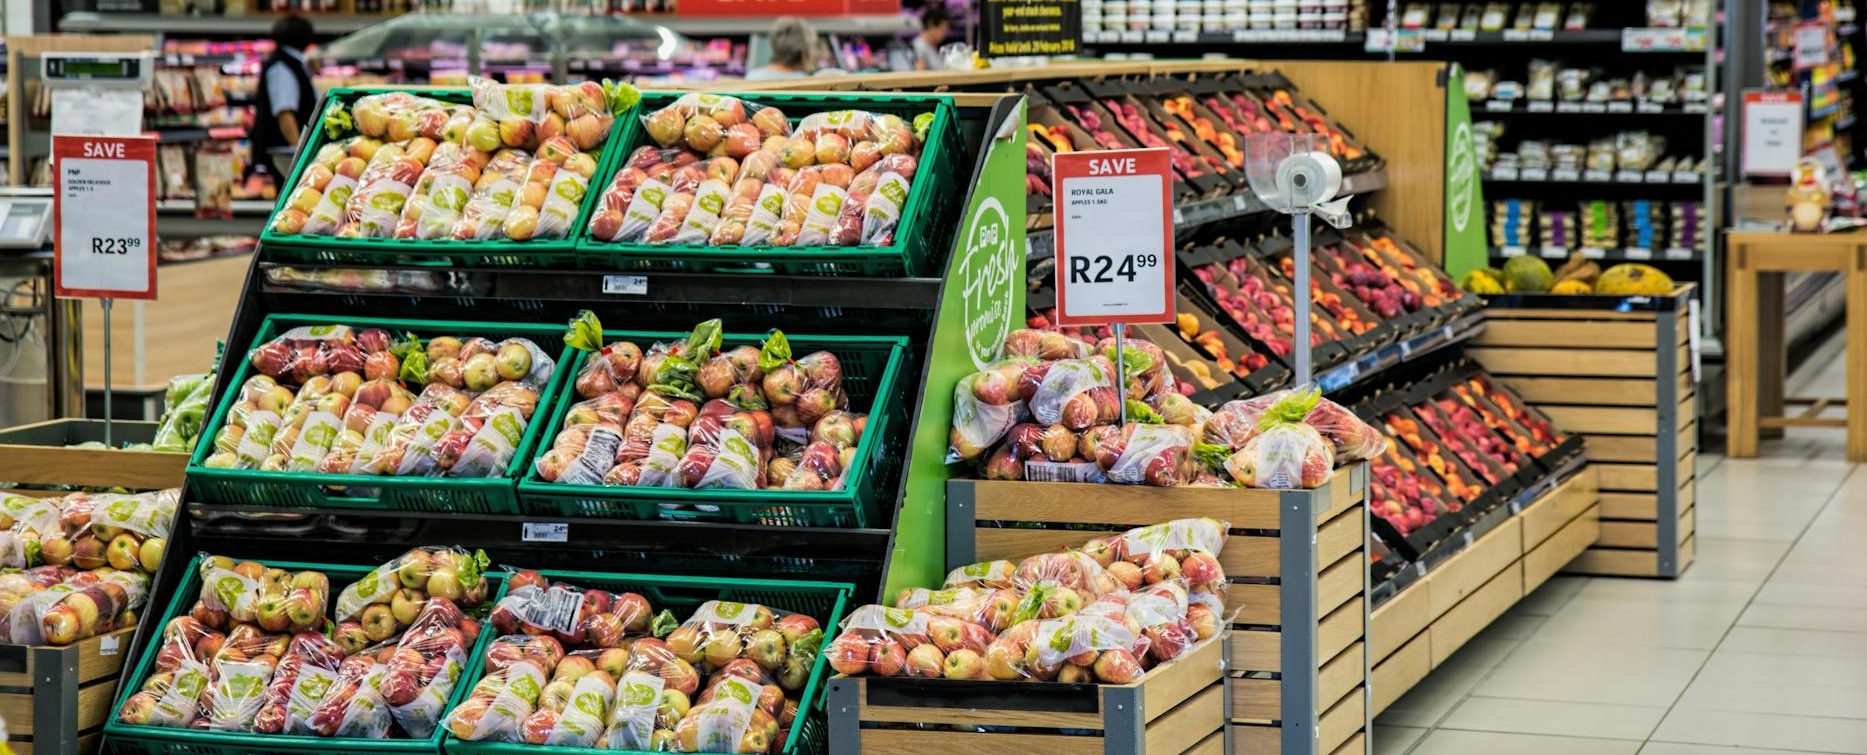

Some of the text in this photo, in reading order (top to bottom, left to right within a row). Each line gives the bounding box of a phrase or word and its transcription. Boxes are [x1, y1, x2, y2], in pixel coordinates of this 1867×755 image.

[83, 142, 125, 158] SAVE
[1089, 158, 1136, 175] SAVE
[958, 214, 1020, 311] Fresh
